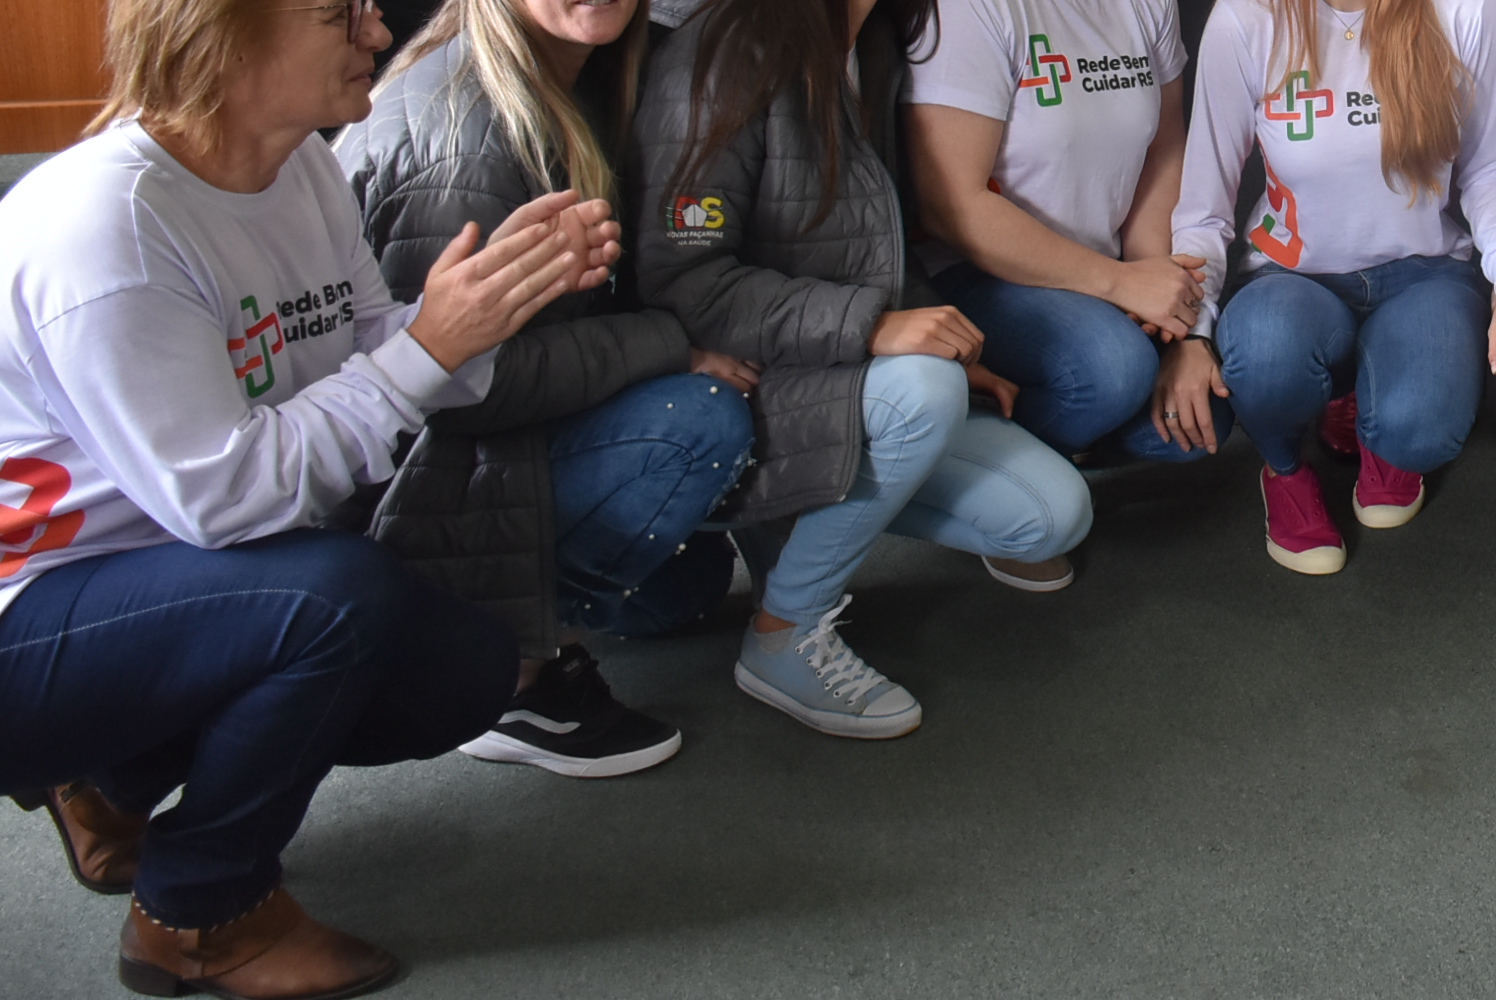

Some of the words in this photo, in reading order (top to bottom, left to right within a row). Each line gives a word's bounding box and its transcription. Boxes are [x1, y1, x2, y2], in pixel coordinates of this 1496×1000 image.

[1077, 55, 1121, 74] Rede
[1082, 73, 1136, 93] Cuidar
[1137, 70, 1154, 87] RS
[276, 290, 322, 318] ede
[283, 313, 338, 343] uidar
